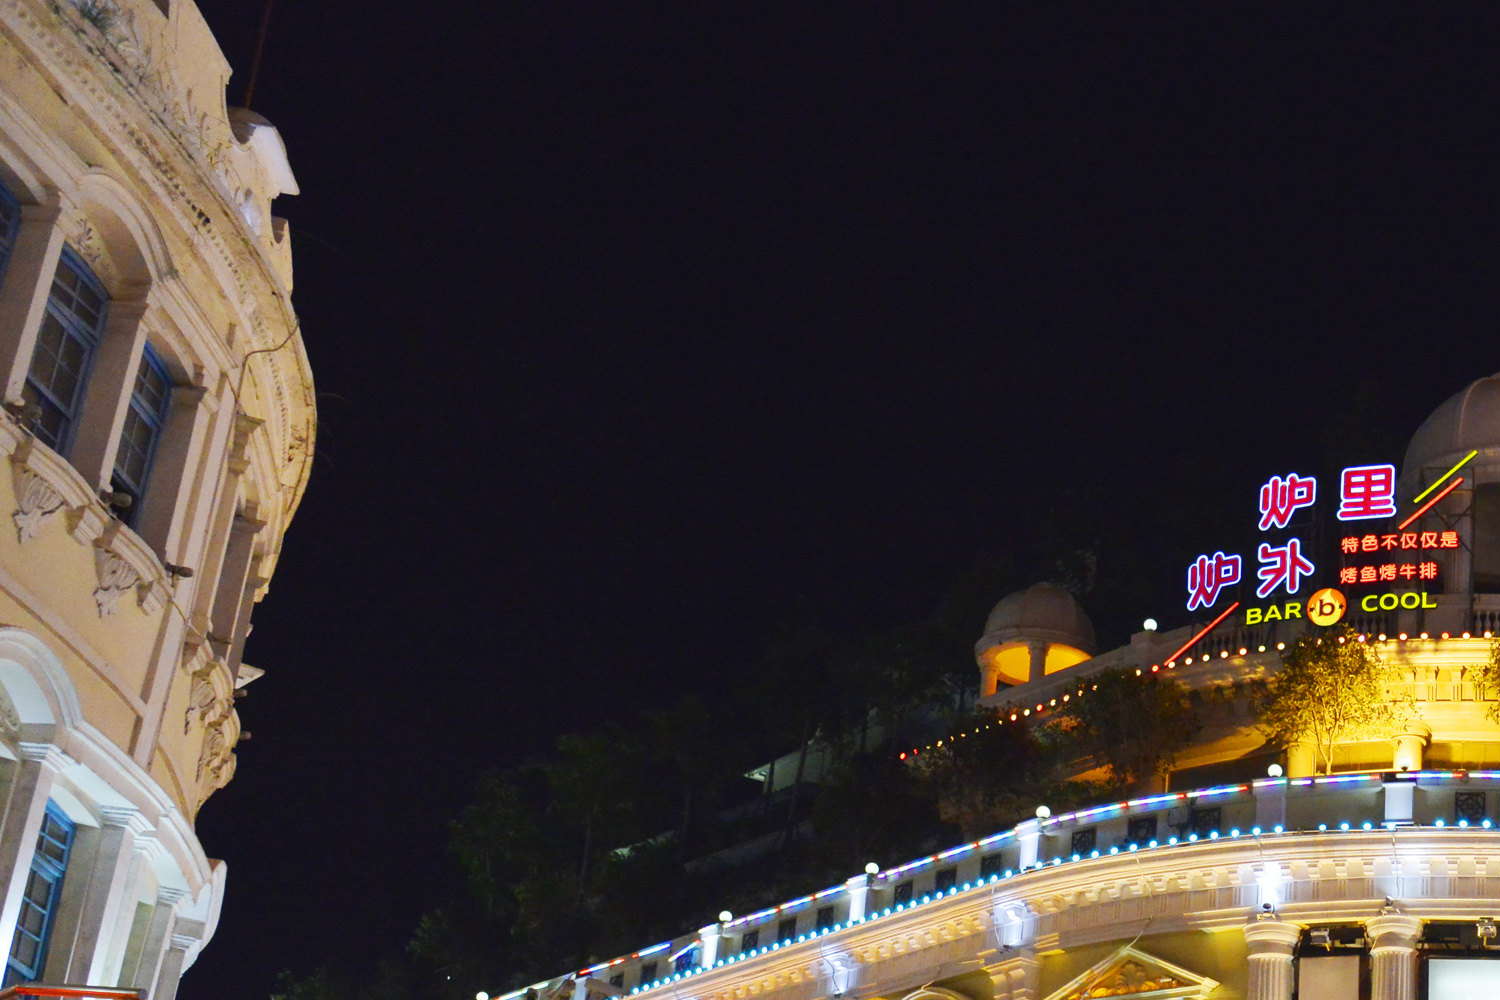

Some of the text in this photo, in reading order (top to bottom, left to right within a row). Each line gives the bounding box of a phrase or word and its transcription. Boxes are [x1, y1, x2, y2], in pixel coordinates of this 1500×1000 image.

[1259, 464, 1396, 531] 炉里
[1341, 531, 1459, 553] 特色不仅仅是
[1187, 538, 1315, 611] 炉外
[1340, 562, 1438, 584] 烤鱼烤牛排
[1246, 603, 1302, 625] BAR
[1362, 592, 1437, 612] COOL
